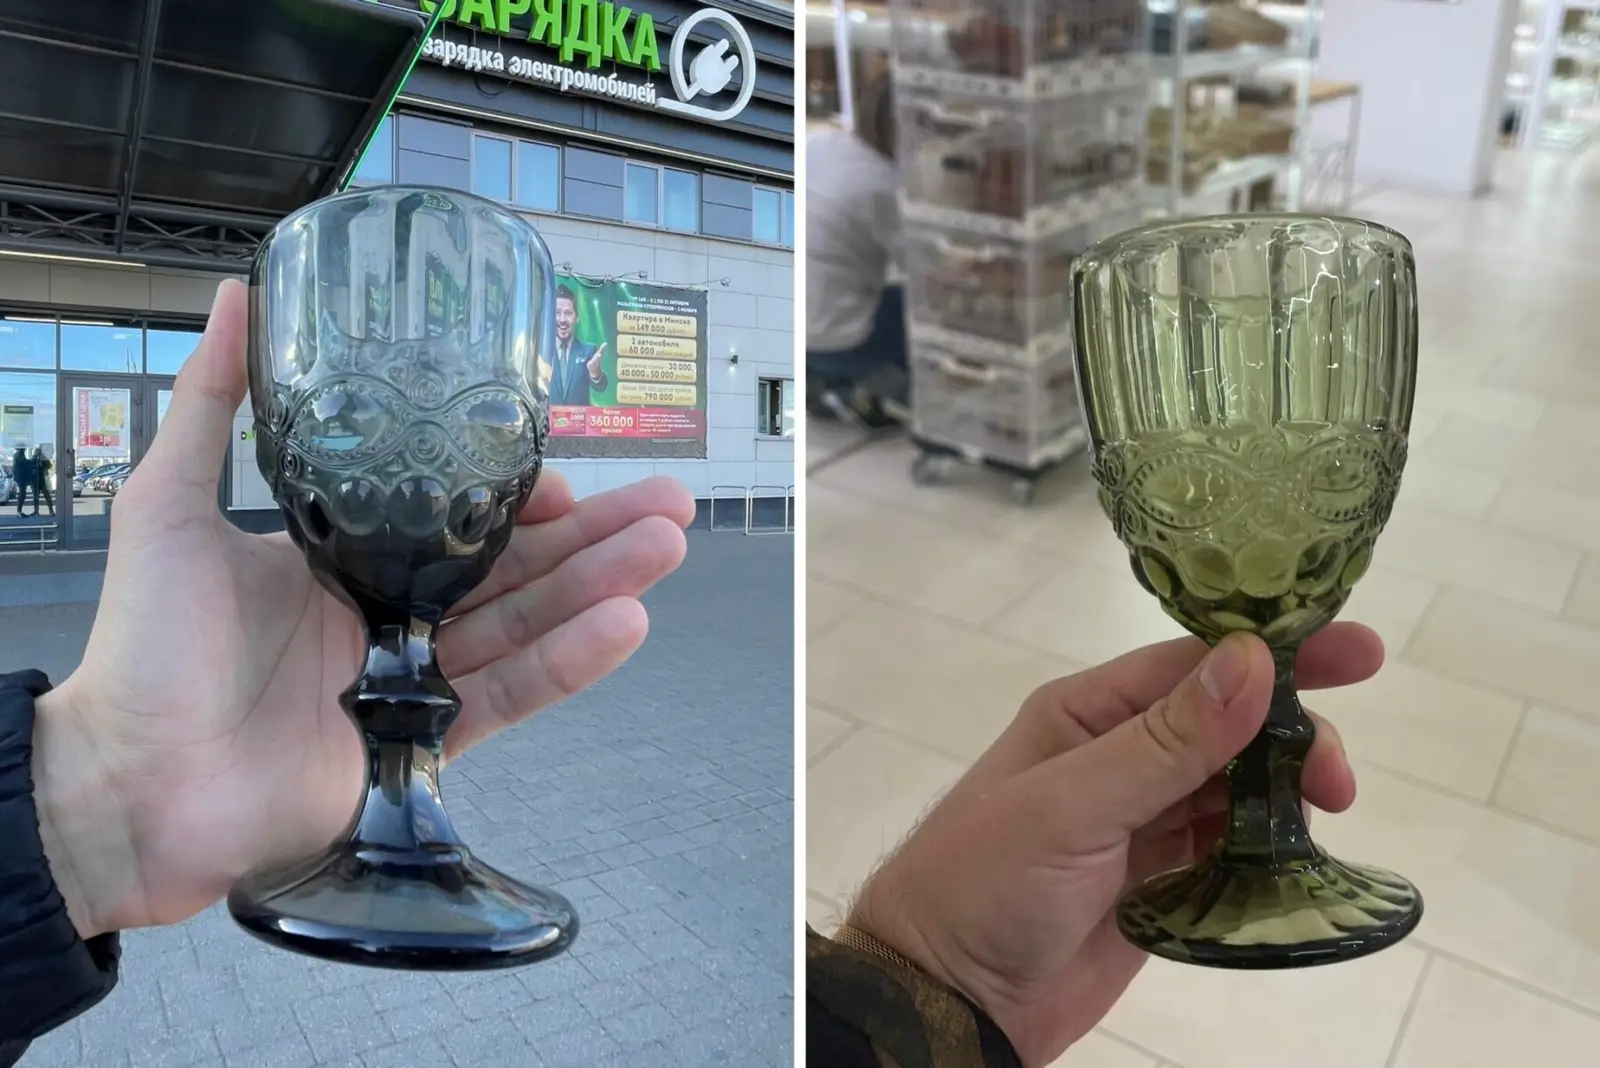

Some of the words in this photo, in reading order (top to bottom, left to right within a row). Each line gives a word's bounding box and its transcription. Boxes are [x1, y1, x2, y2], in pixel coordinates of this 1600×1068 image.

[422, 37, 505, 72] зарядка
[508, 56, 657, 104] электромобилей
[622, 313, 657, 323] Квартира
[636, 323, 650, 331] 149
[651, 324, 666, 333] 000
[631, 336, 636, 345] 2
[644, 392, 658, 400] 790
[659, 393, 674, 401] 000
[590, 415, 610, 427] 360
[612, 416, 634, 428] 000
